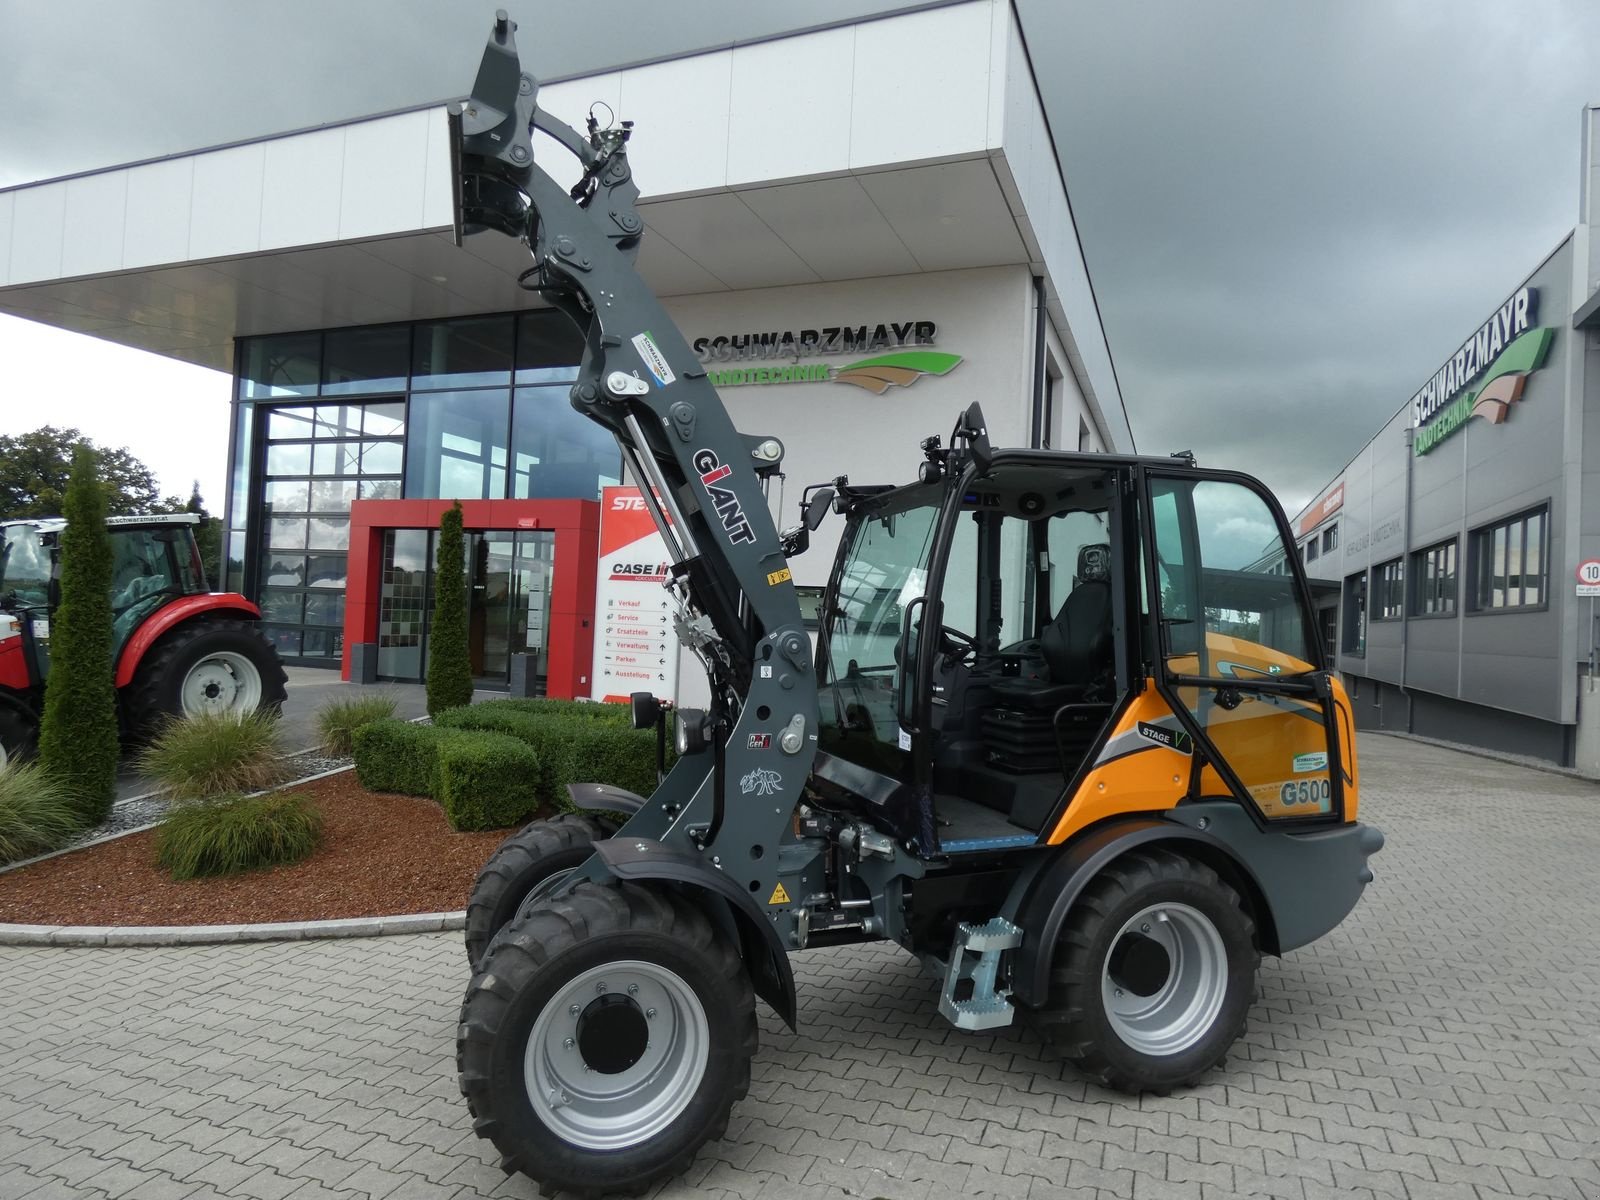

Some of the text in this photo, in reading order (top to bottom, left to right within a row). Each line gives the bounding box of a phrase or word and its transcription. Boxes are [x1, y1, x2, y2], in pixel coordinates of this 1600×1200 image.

[693, 320, 937, 364] SCHWARZMAYR
[1413, 287, 1530, 428] SCHWARZMAYR
[706, 364, 830, 386] ANDTECHNIK
[1415, 391, 1474, 455] LANDTECHNIK
[612, 563, 653, 575] CASE
[1586, 566, 1599, 579] 10
[618, 599, 641, 607] Verkauf
[617, 628, 648, 636] Ersatzteile
[616, 642, 649, 651] Verwaltung
[615, 655, 636, 663] Parken
[615, 670, 650, 680] Ausstellung
[1142, 727, 1170, 744] STAGE
